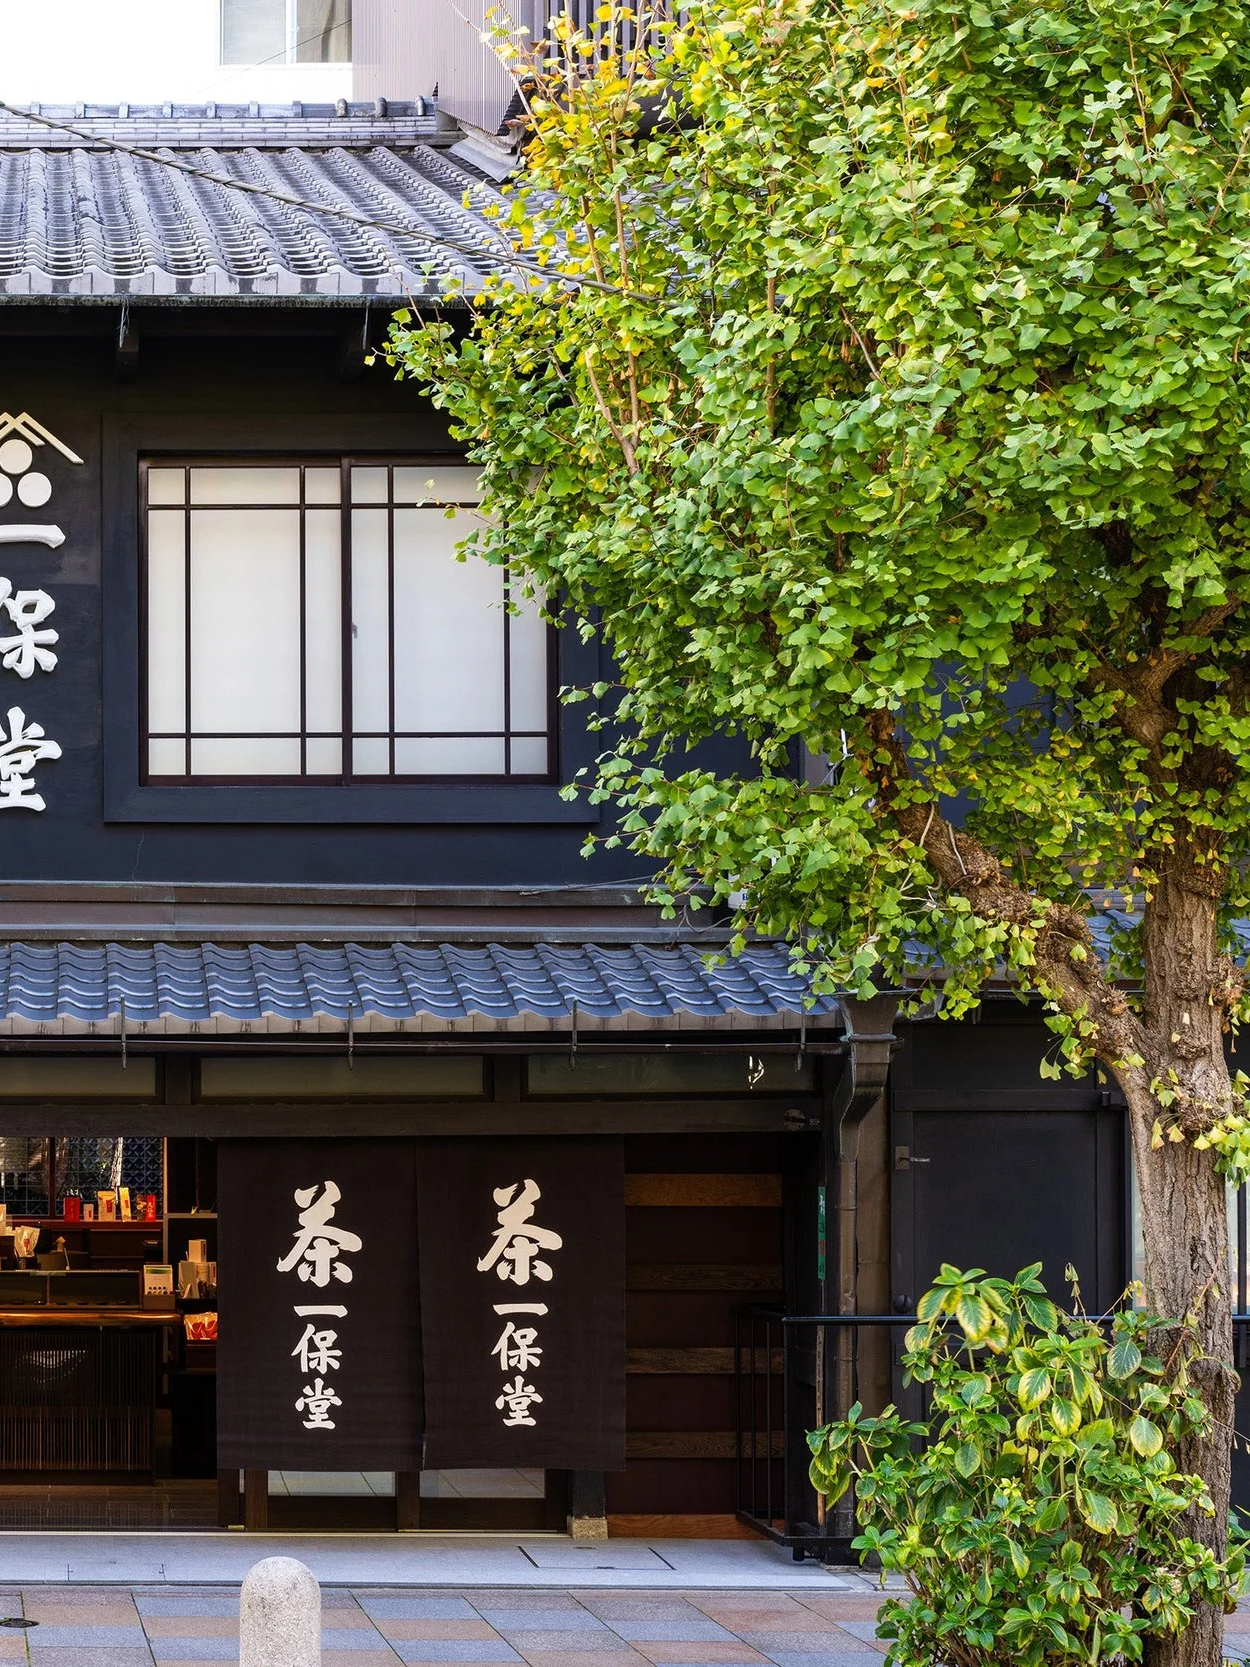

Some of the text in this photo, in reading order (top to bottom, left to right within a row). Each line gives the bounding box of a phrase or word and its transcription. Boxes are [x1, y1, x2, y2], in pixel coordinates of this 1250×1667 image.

[277, 1181, 362, 1429] 茶一保堂
[477, 1179, 562, 1426] 茶一保堂
